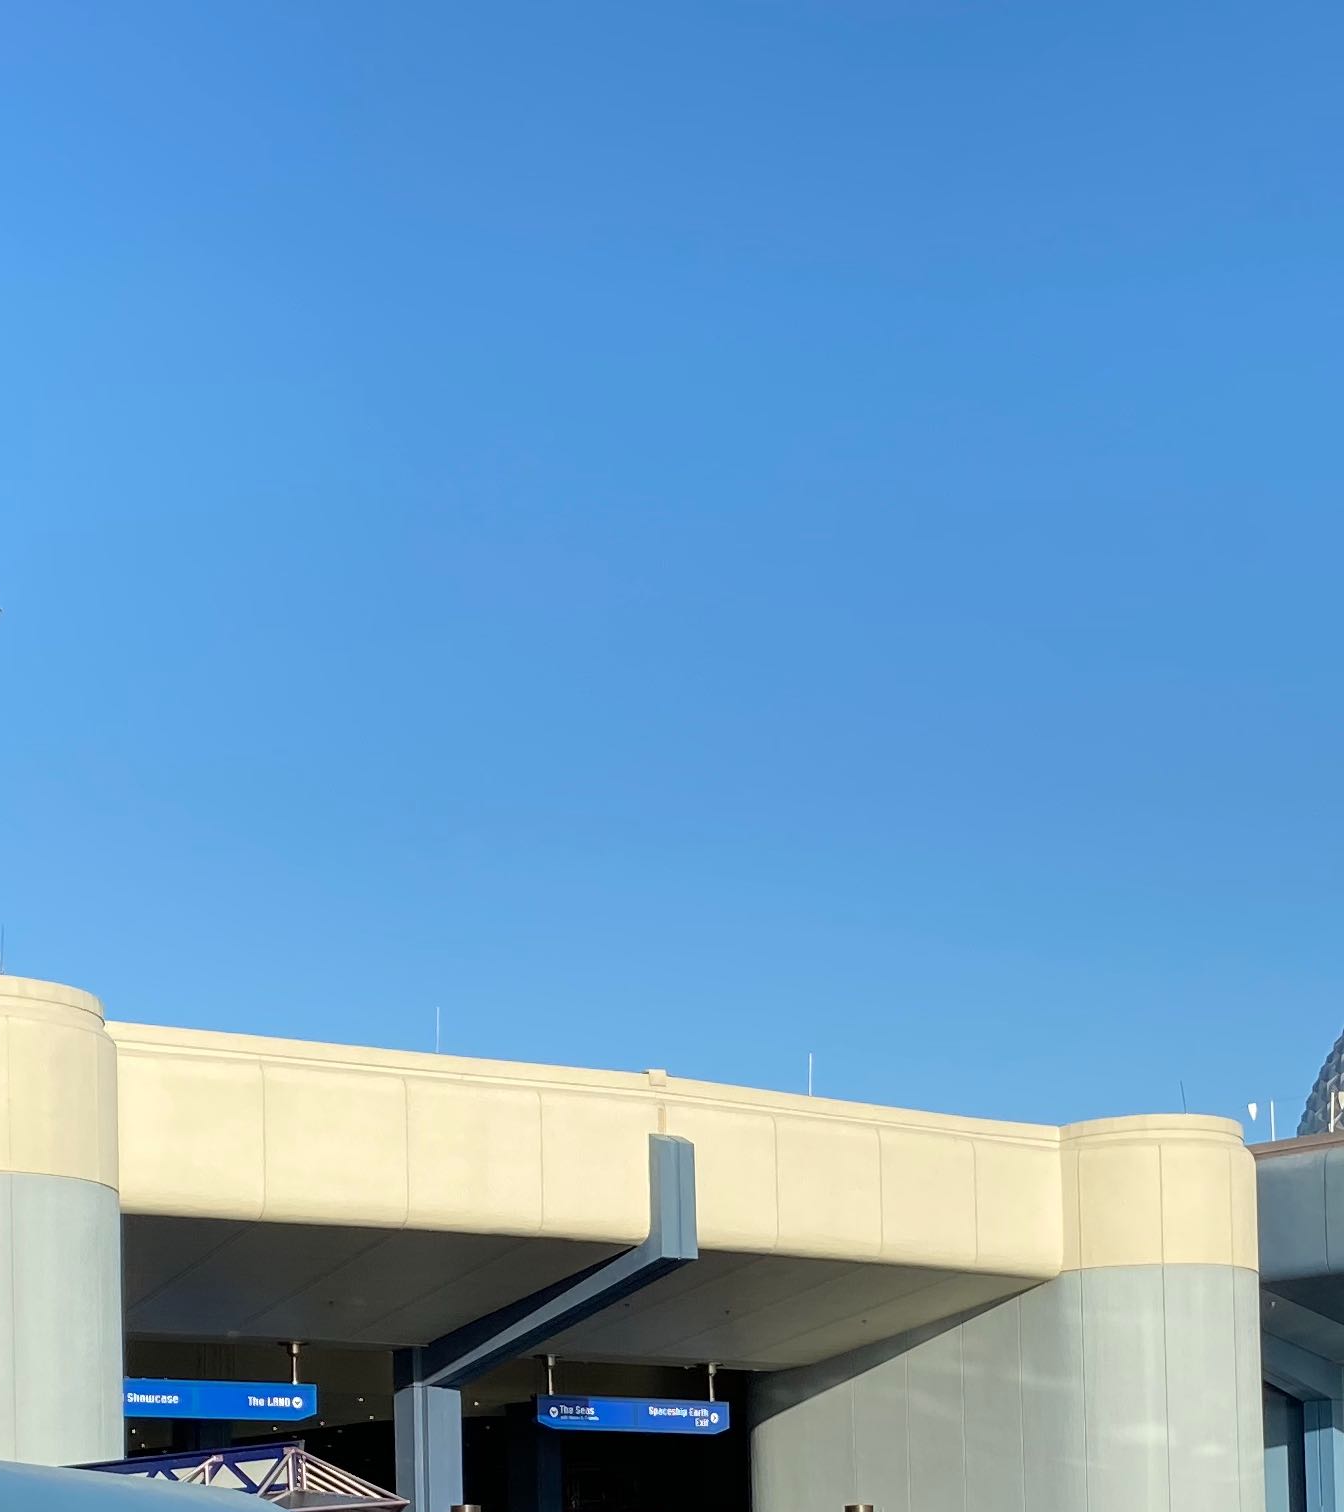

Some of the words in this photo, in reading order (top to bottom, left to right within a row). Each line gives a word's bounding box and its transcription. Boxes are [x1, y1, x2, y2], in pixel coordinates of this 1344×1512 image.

[127, 1392, 179, 1404] Showcase
[248, 1396, 265, 1407] The
[560, 1404, 574, 1415] The
[575, 1405, 595, 1416] Seas
[648, 1406, 688, 1418] Spaceship
[689, 1408, 709, 1417] Earth
